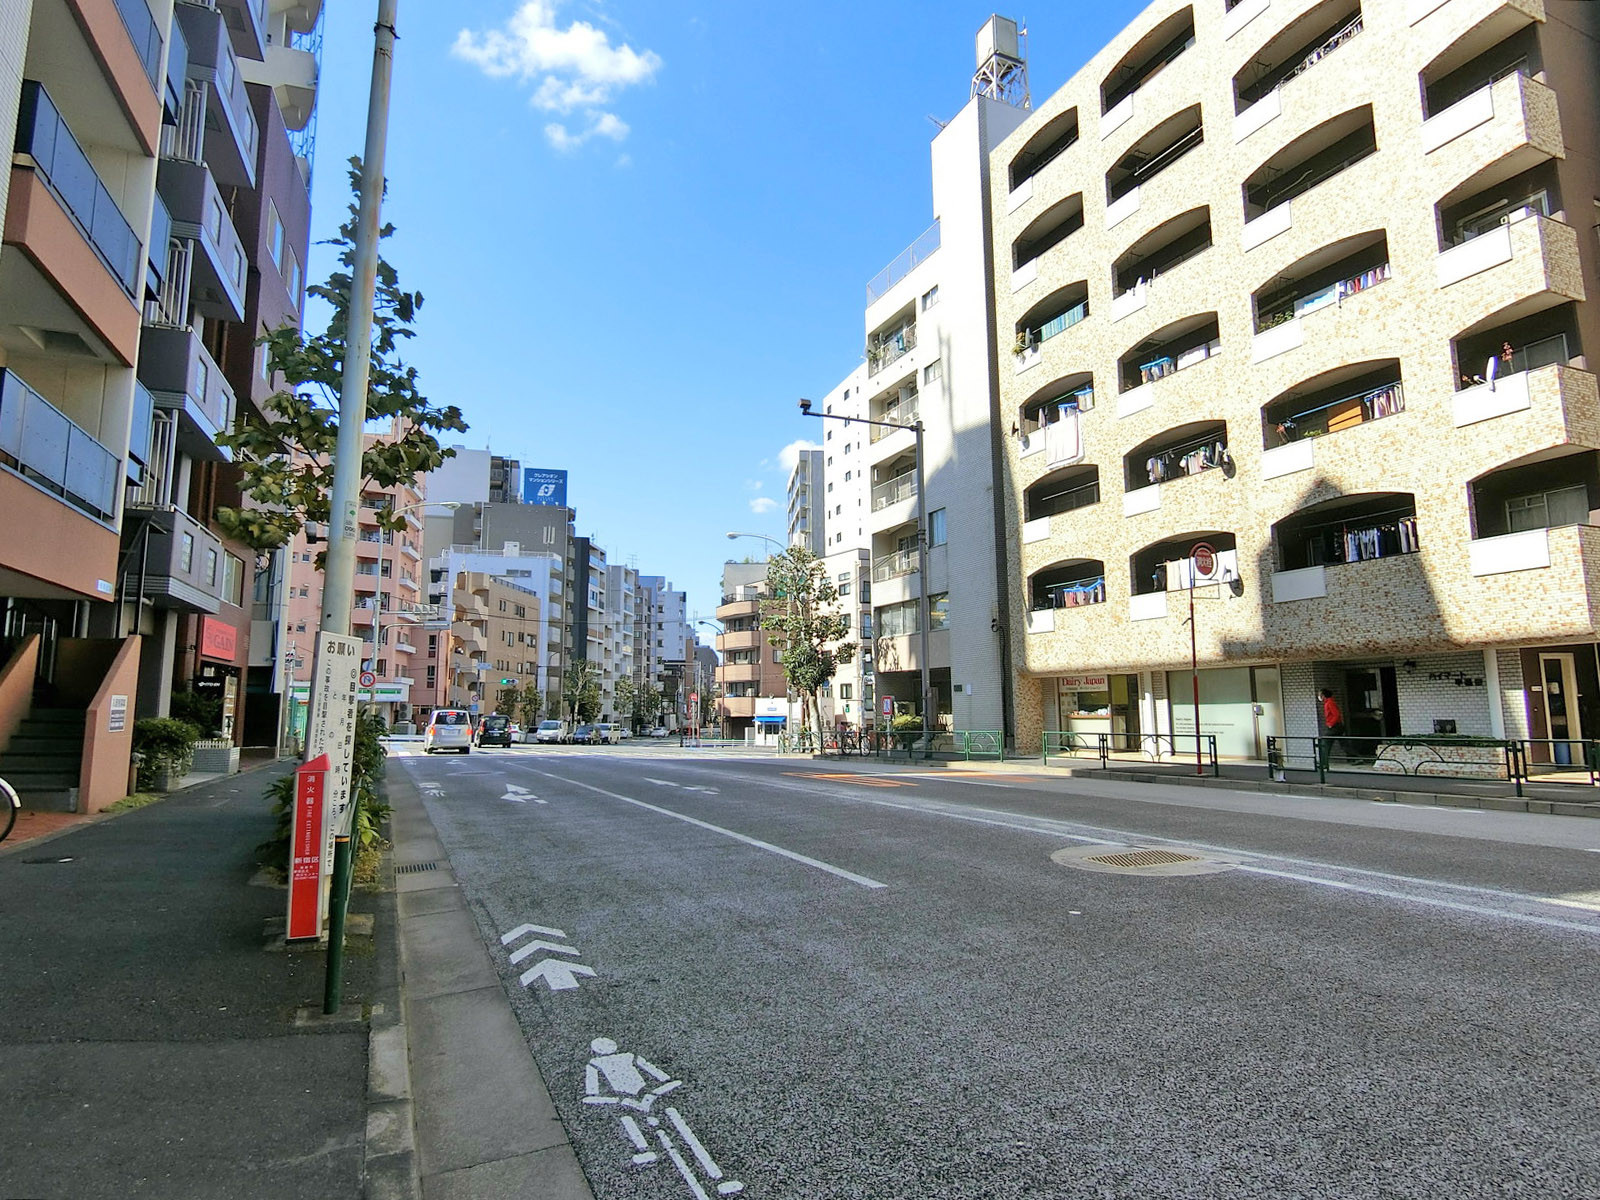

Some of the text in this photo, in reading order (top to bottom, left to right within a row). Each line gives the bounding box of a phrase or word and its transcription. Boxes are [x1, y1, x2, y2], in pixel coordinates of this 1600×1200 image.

[327, 640, 356, 657] お願い
[1062, 676, 1105, 687] Dairy Japan
